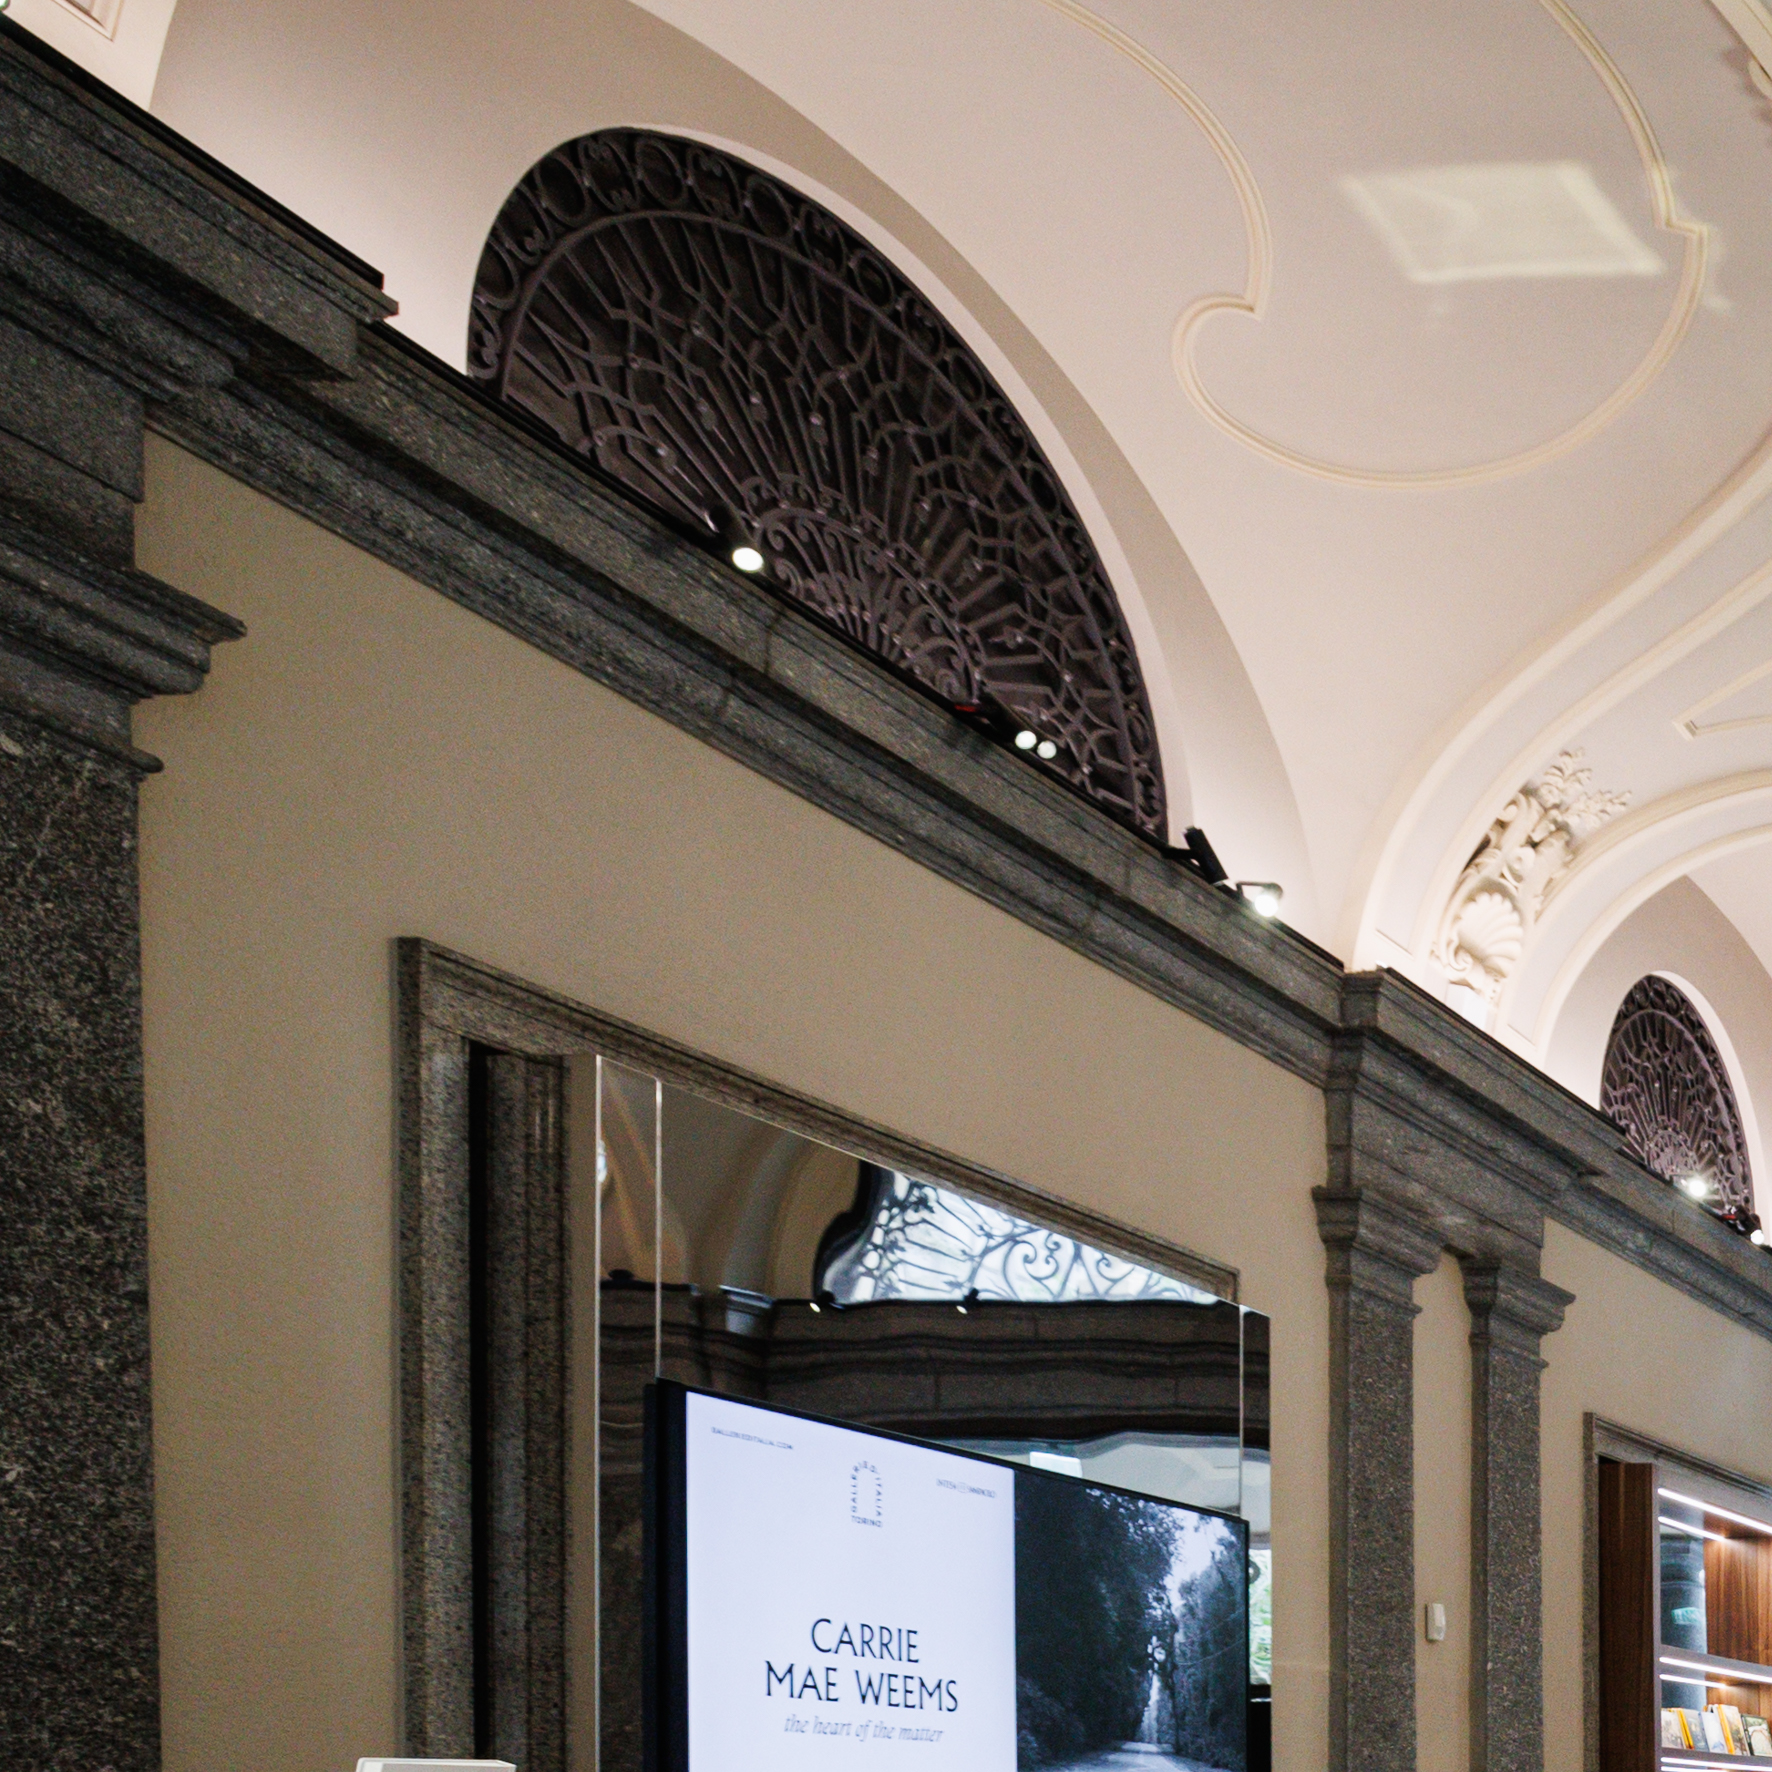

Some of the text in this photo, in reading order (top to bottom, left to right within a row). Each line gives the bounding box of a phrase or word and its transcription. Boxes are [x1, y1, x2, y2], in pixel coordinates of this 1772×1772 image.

[850, 1515, 882, 1528] TORINO
[811, 1617, 920, 1664] CARRIE
[765, 1660, 959, 1712] MAE WEEMS
[784, 1714, 944, 1742] the heart of the matter
